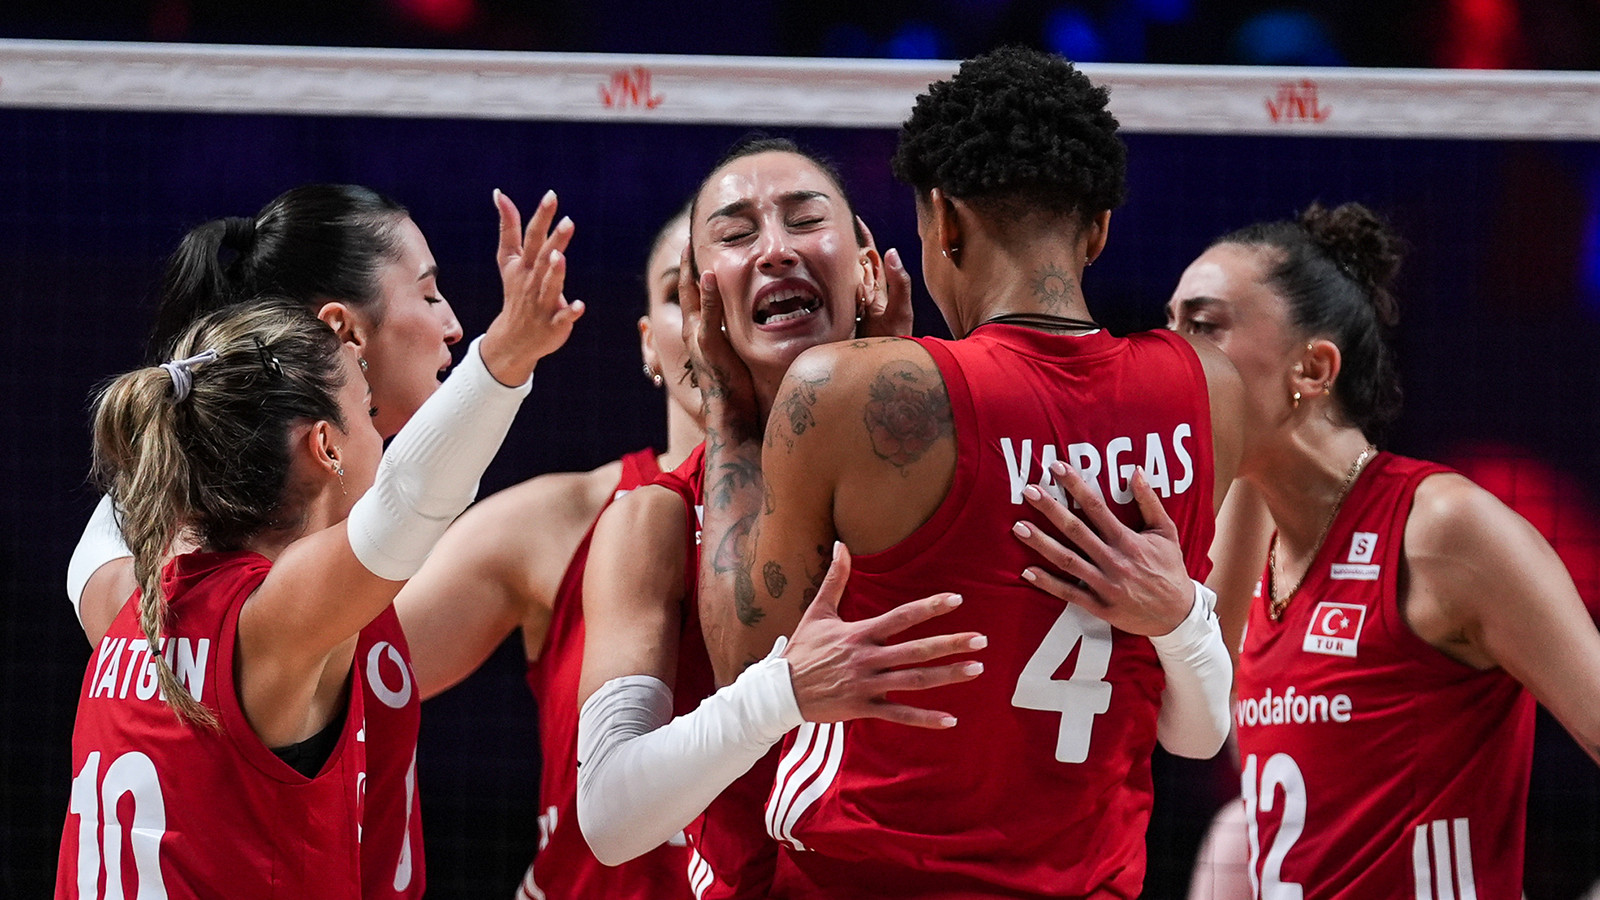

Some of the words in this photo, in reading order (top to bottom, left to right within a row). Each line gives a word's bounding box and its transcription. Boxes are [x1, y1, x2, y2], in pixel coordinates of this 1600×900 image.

[1000, 423, 1194, 509] VARGAS
[1355, 538, 1369, 556] S
[1011, 579, 1113, 764] 4
[1317, 639, 1344, 651] TUR
[1237, 685, 1353, 728] vodafone
[70, 750, 169, 900] 10
[1241, 752, 1307, 900] 12
